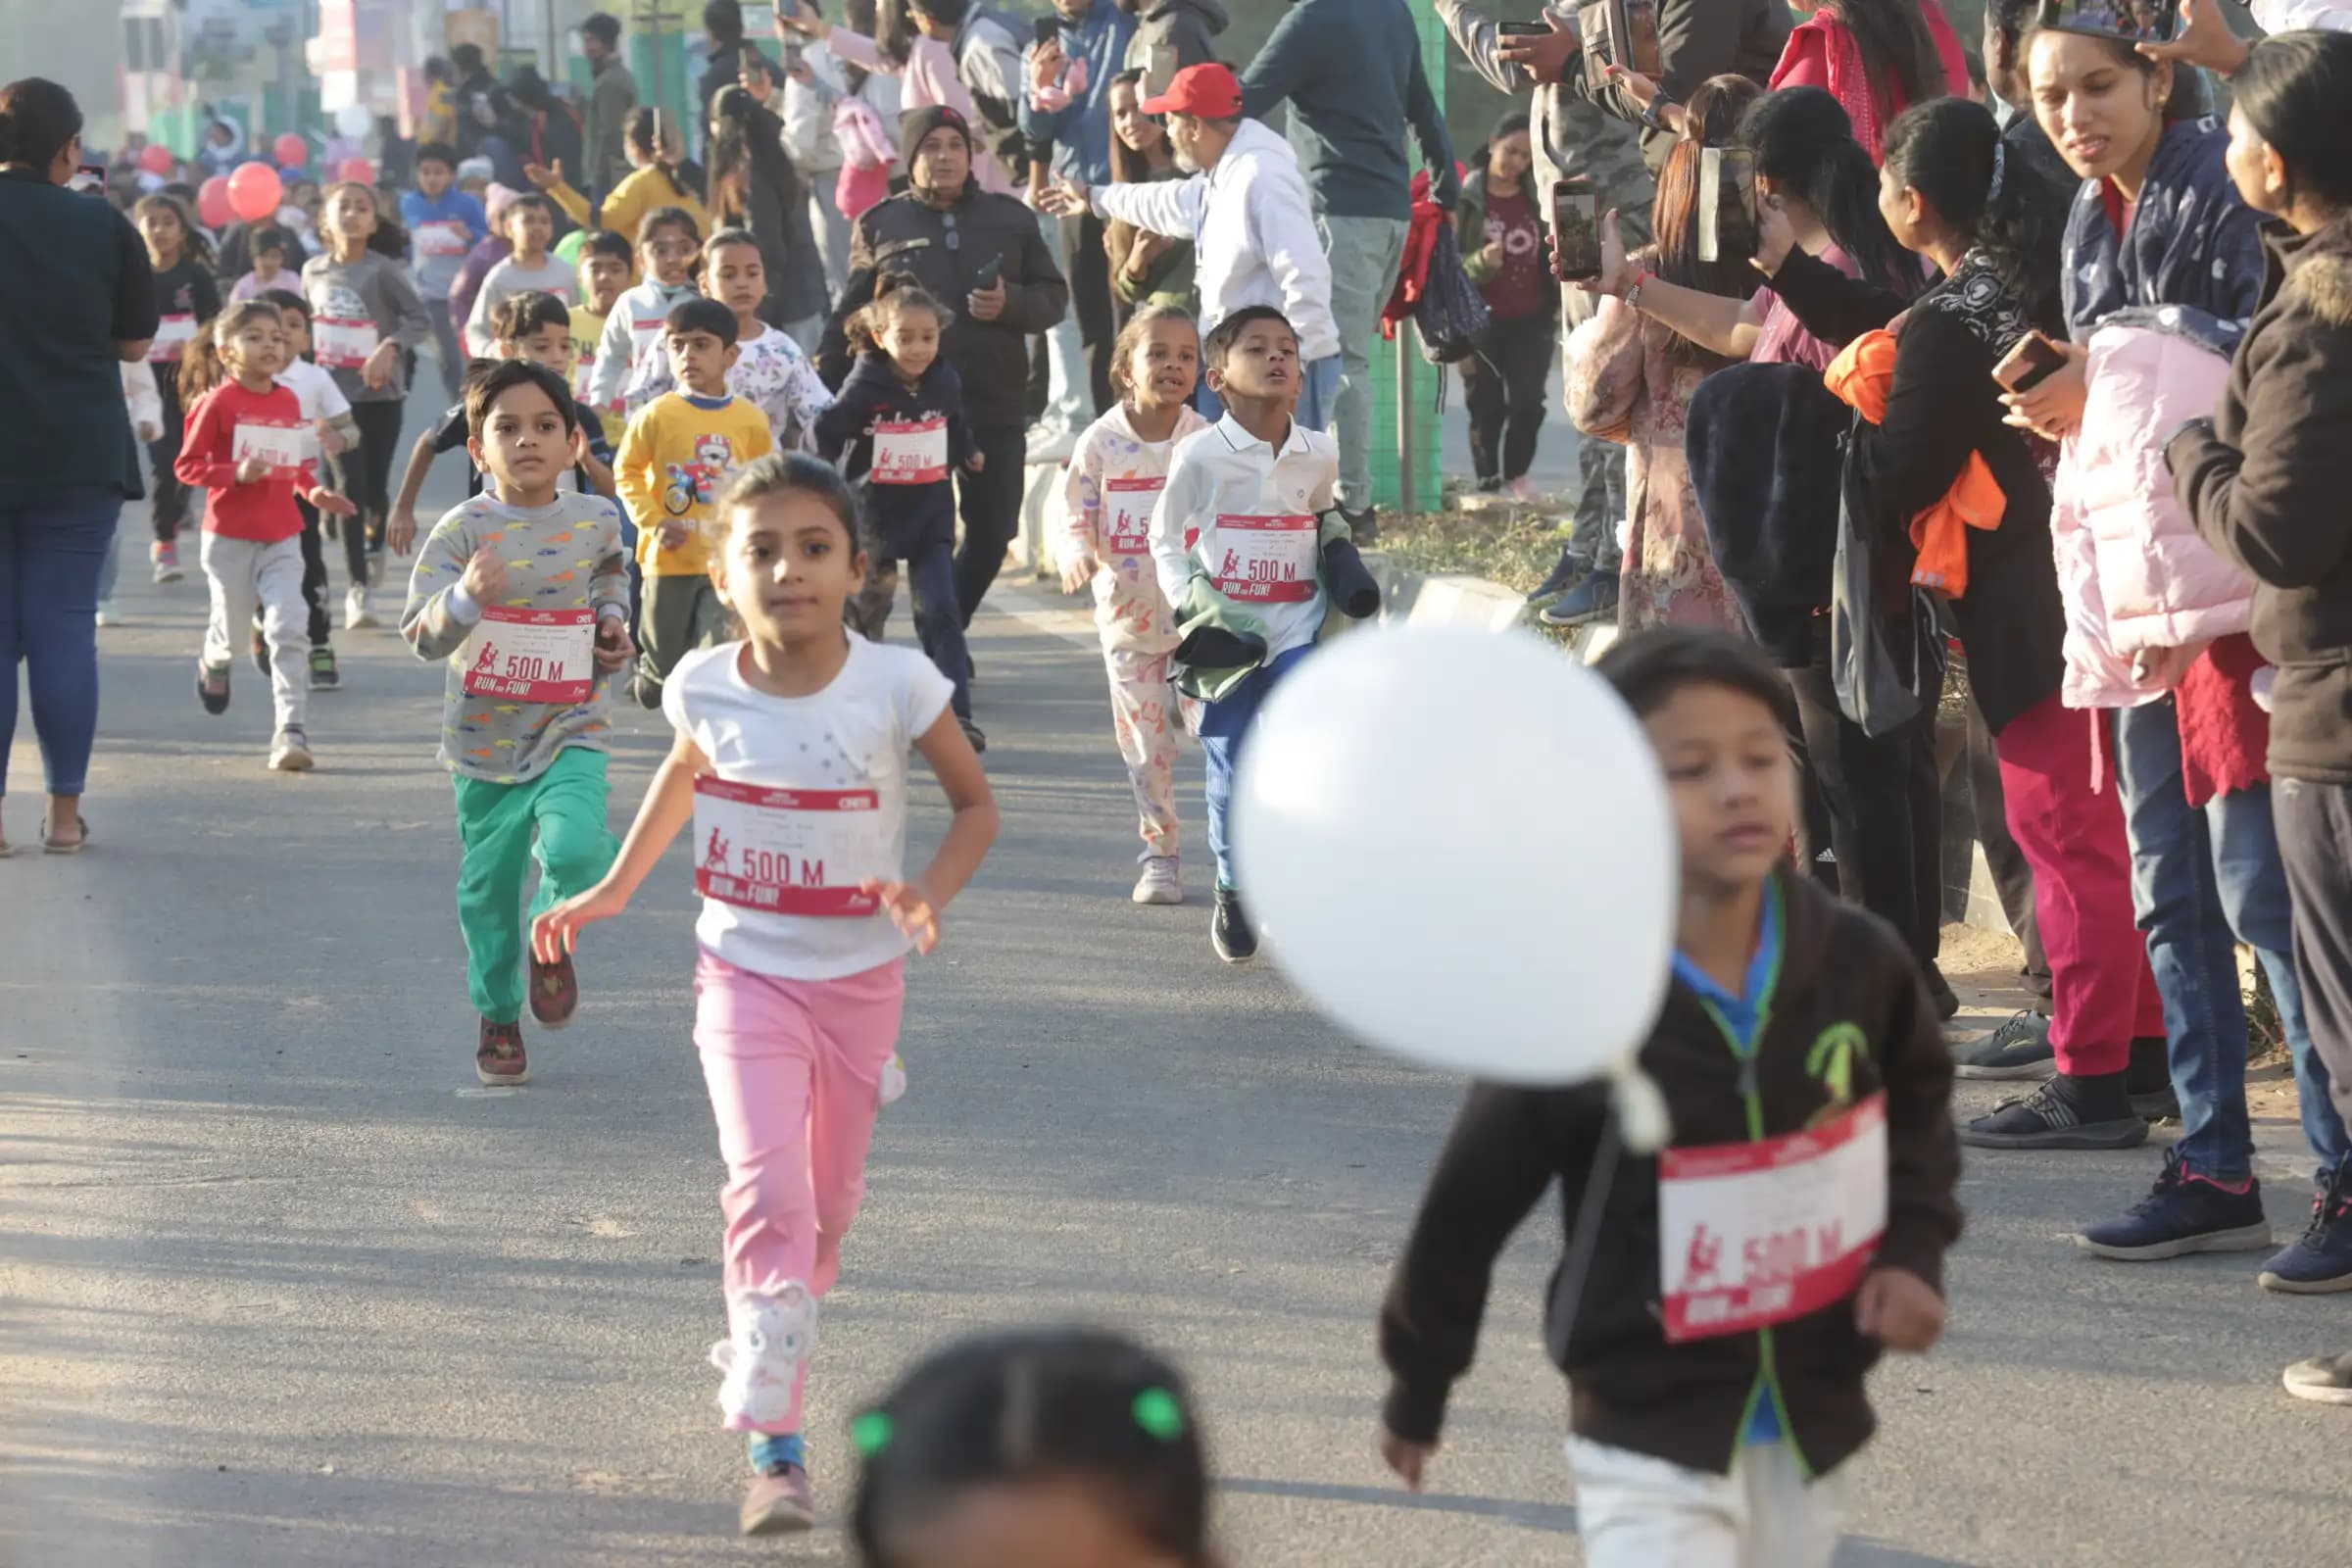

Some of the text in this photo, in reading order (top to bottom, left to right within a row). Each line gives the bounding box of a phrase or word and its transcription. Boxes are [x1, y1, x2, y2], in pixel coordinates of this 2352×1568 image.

[899, 455, 933, 470] 500 M
[1248, 560, 1296, 582] 500 M
[1221, 582, 1241, 595] RUN
[1249, 583, 1271, 597] FUN!
[506, 656, 564, 681] 500 M
[474, 675, 498, 692] RUN
[505, 680, 531, 696] FUN!
[743, 848, 824, 886] 500 M
[709, 874, 734, 899] RUN
[747, 883, 780, 906] FUN!
[1742, 1228, 1806, 1282] 500
